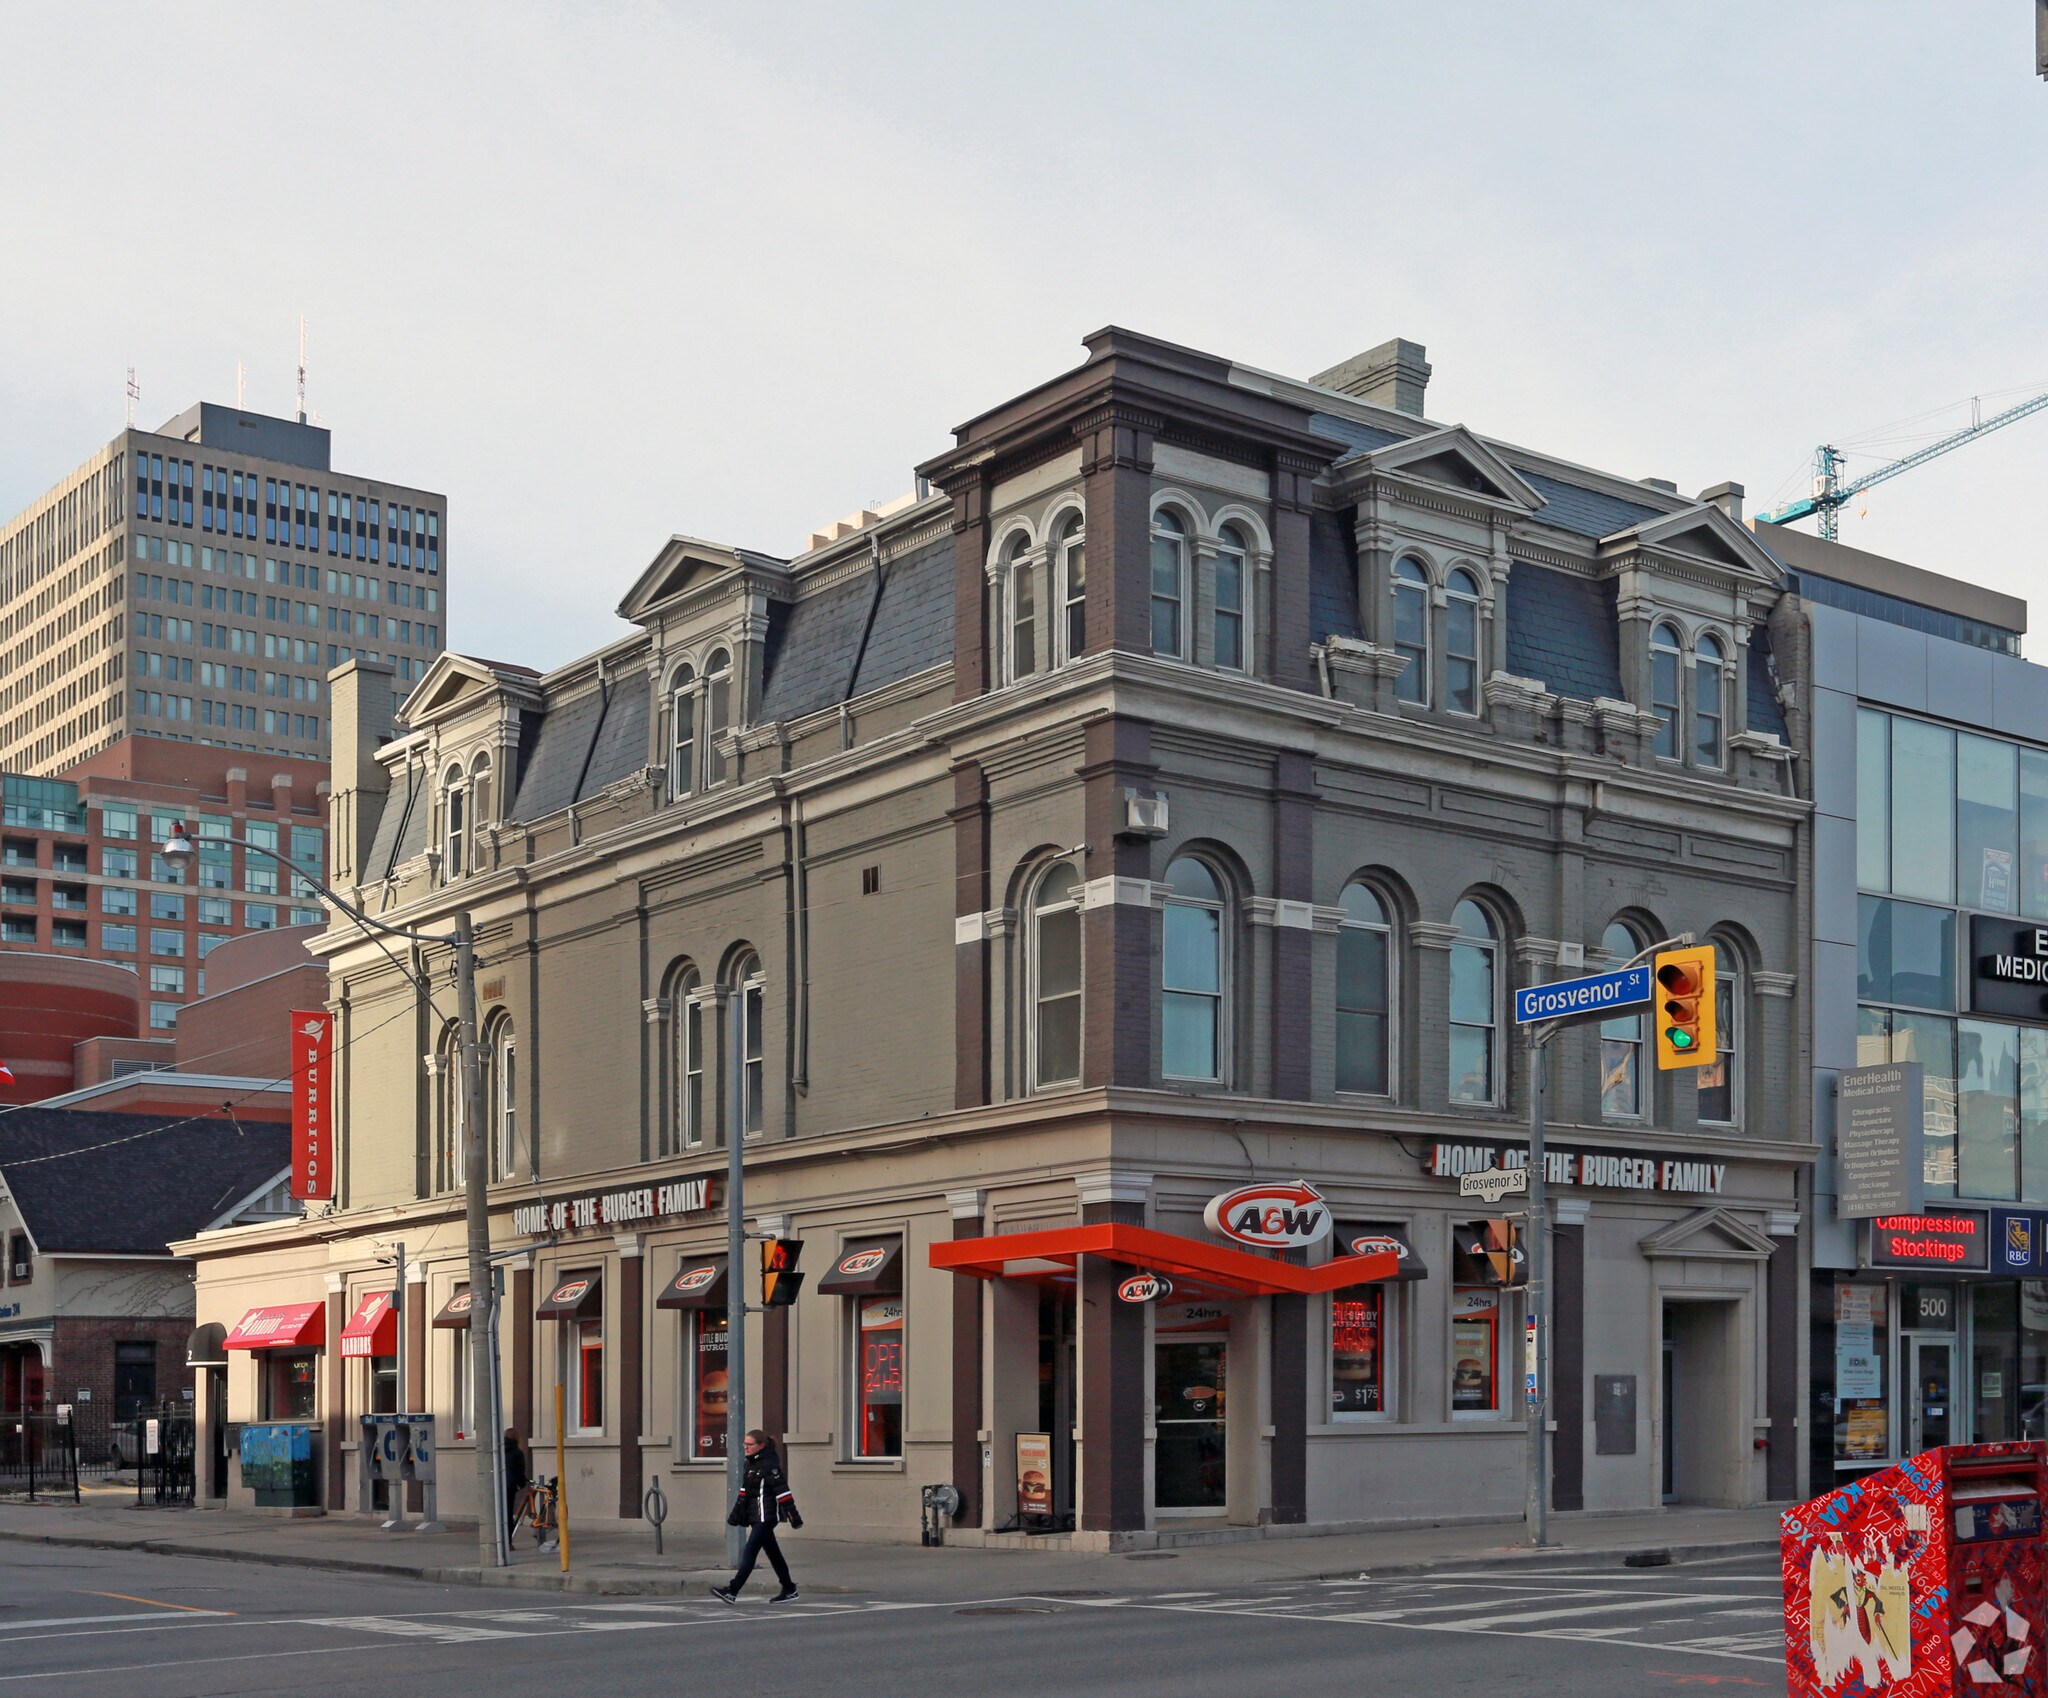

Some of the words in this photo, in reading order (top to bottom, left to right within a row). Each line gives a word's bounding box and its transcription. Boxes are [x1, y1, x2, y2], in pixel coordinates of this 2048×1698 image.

[1524, 980, 1623, 1015] Grosvenor
[1629, 973, 1640, 986] St
[1843, 1069, 1902, 1087] EnerHealth
[1843, 1086, 1874, 1098] Medical
[1875, 1084, 1902, 1094] Centre
[1852, 1105, 1891, 1117] Chiropractic
[307, 1048, 318, 1194] BURRITOS
[1851, 1117, 1892, 1127] Acupuncture
[1849, 1128, 1895, 1138] Physiotherapy
[1844, 1140, 1873, 1149] Massage
[1874, 1137, 1900, 1146] Therapy
[1844, 1160, 1879, 1170] Orthopedic
[1880, 1159, 1900, 1167] Shoes
[1463, 1176, 1511, 1191] Grosvenor
[1513, 1173, 1523, 1187] St
[1583, 1154, 1655, 1190] BURGER
[1662, 1161, 1726, 1194] FAMILY
[513, 1201, 549, 1235] HOME
[552, 1201, 569, 1231] OF
[572, 1196, 597, 1228] THE
[602, 1188, 654, 1225] BURGER
[657, 1179, 708, 1215] FAMILY
[1232, 1206, 1323, 1236] A&W
[1875, 1215, 1976, 1235] Compression
[1890, 1237, 1966, 1262] Stockings
[2009, 1250, 2028, 1262] RBC
[1126, 1283, 1155, 1298] A&W
[1467, 1297, 1492, 1308] 24hrs
[1920, 1298, 1946, 1316] 500
[1186, 1308, 1223, 1319] 24hrs
[714, 1332, 728, 1343] BUD
[187, 1350, 193, 1361] 2
[867, 1344, 902, 1372] OPE
[1898, 1460, 1932, 1491] M6S
[1897, 1477, 1924, 1504] R7N
[1818, 1482, 1865, 1526] K4A
[1860, 1523, 1885, 1544] J5T
[1916, 1585, 1950, 1619] K4A
[1786, 1610, 1811, 1631] J5T
[1937, 1655, 1952, 1672] B2J
